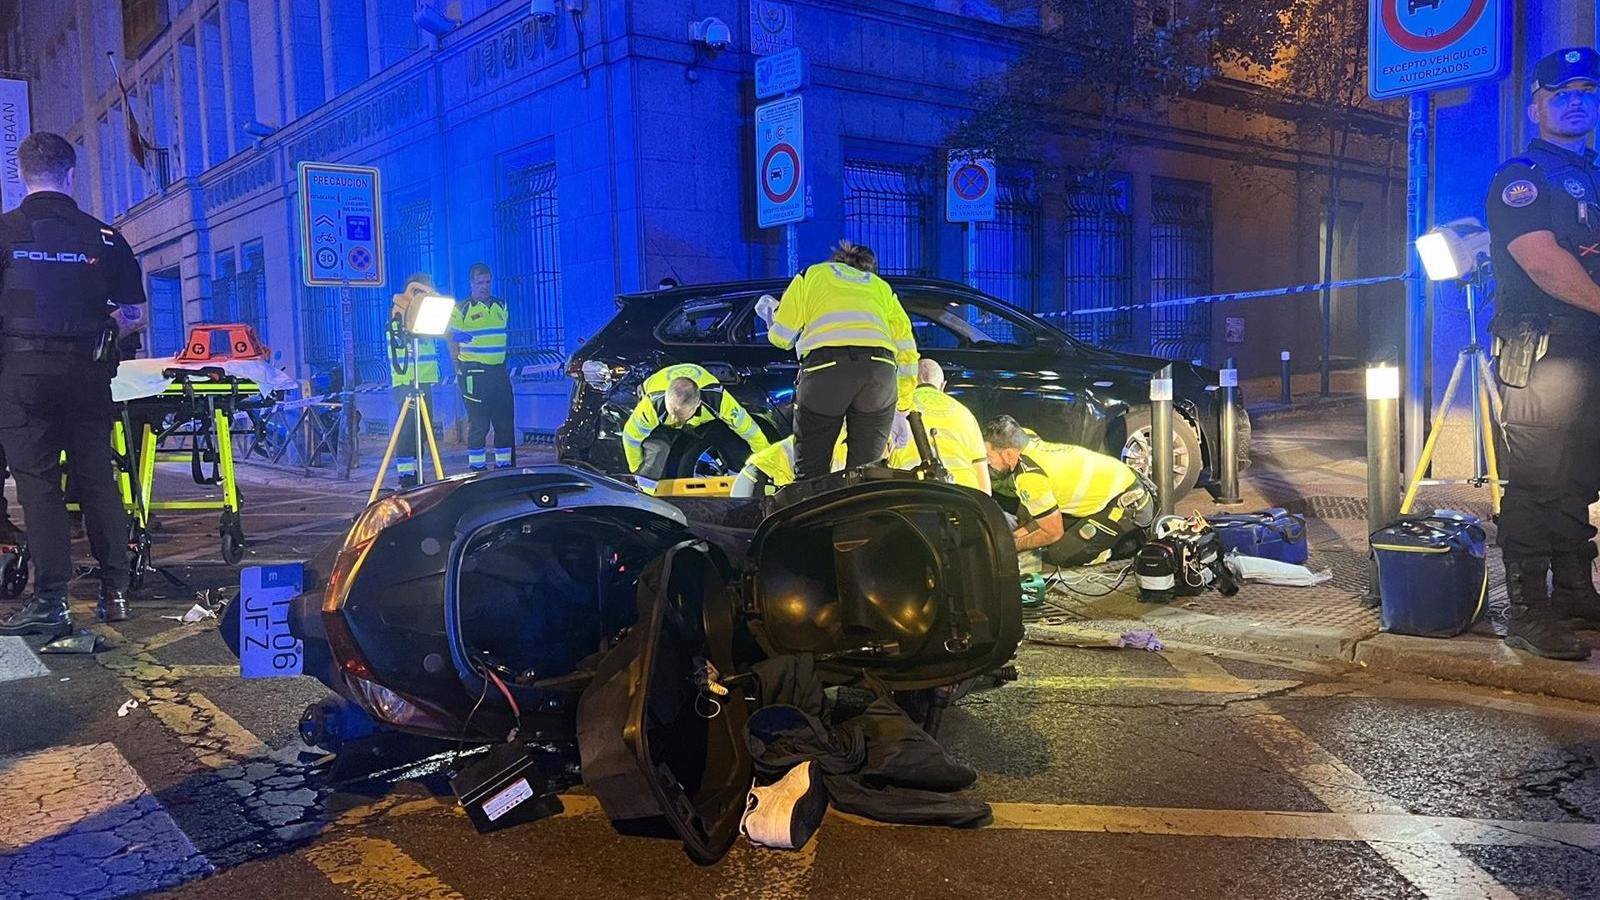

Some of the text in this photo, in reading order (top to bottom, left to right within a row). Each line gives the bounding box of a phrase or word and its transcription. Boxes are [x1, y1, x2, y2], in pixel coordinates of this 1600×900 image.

[1383, 46, 1488, 75] EXCEPTO VEHICULOS
[1399, 62, 1470, 83] AUTORIZADOS
[3, 103, 20, 183] IWAN BAAN
[320, 253, 333, 263] 30
[268, 572, 278, 581] E
[245, 597, 269, 651] JFZ
